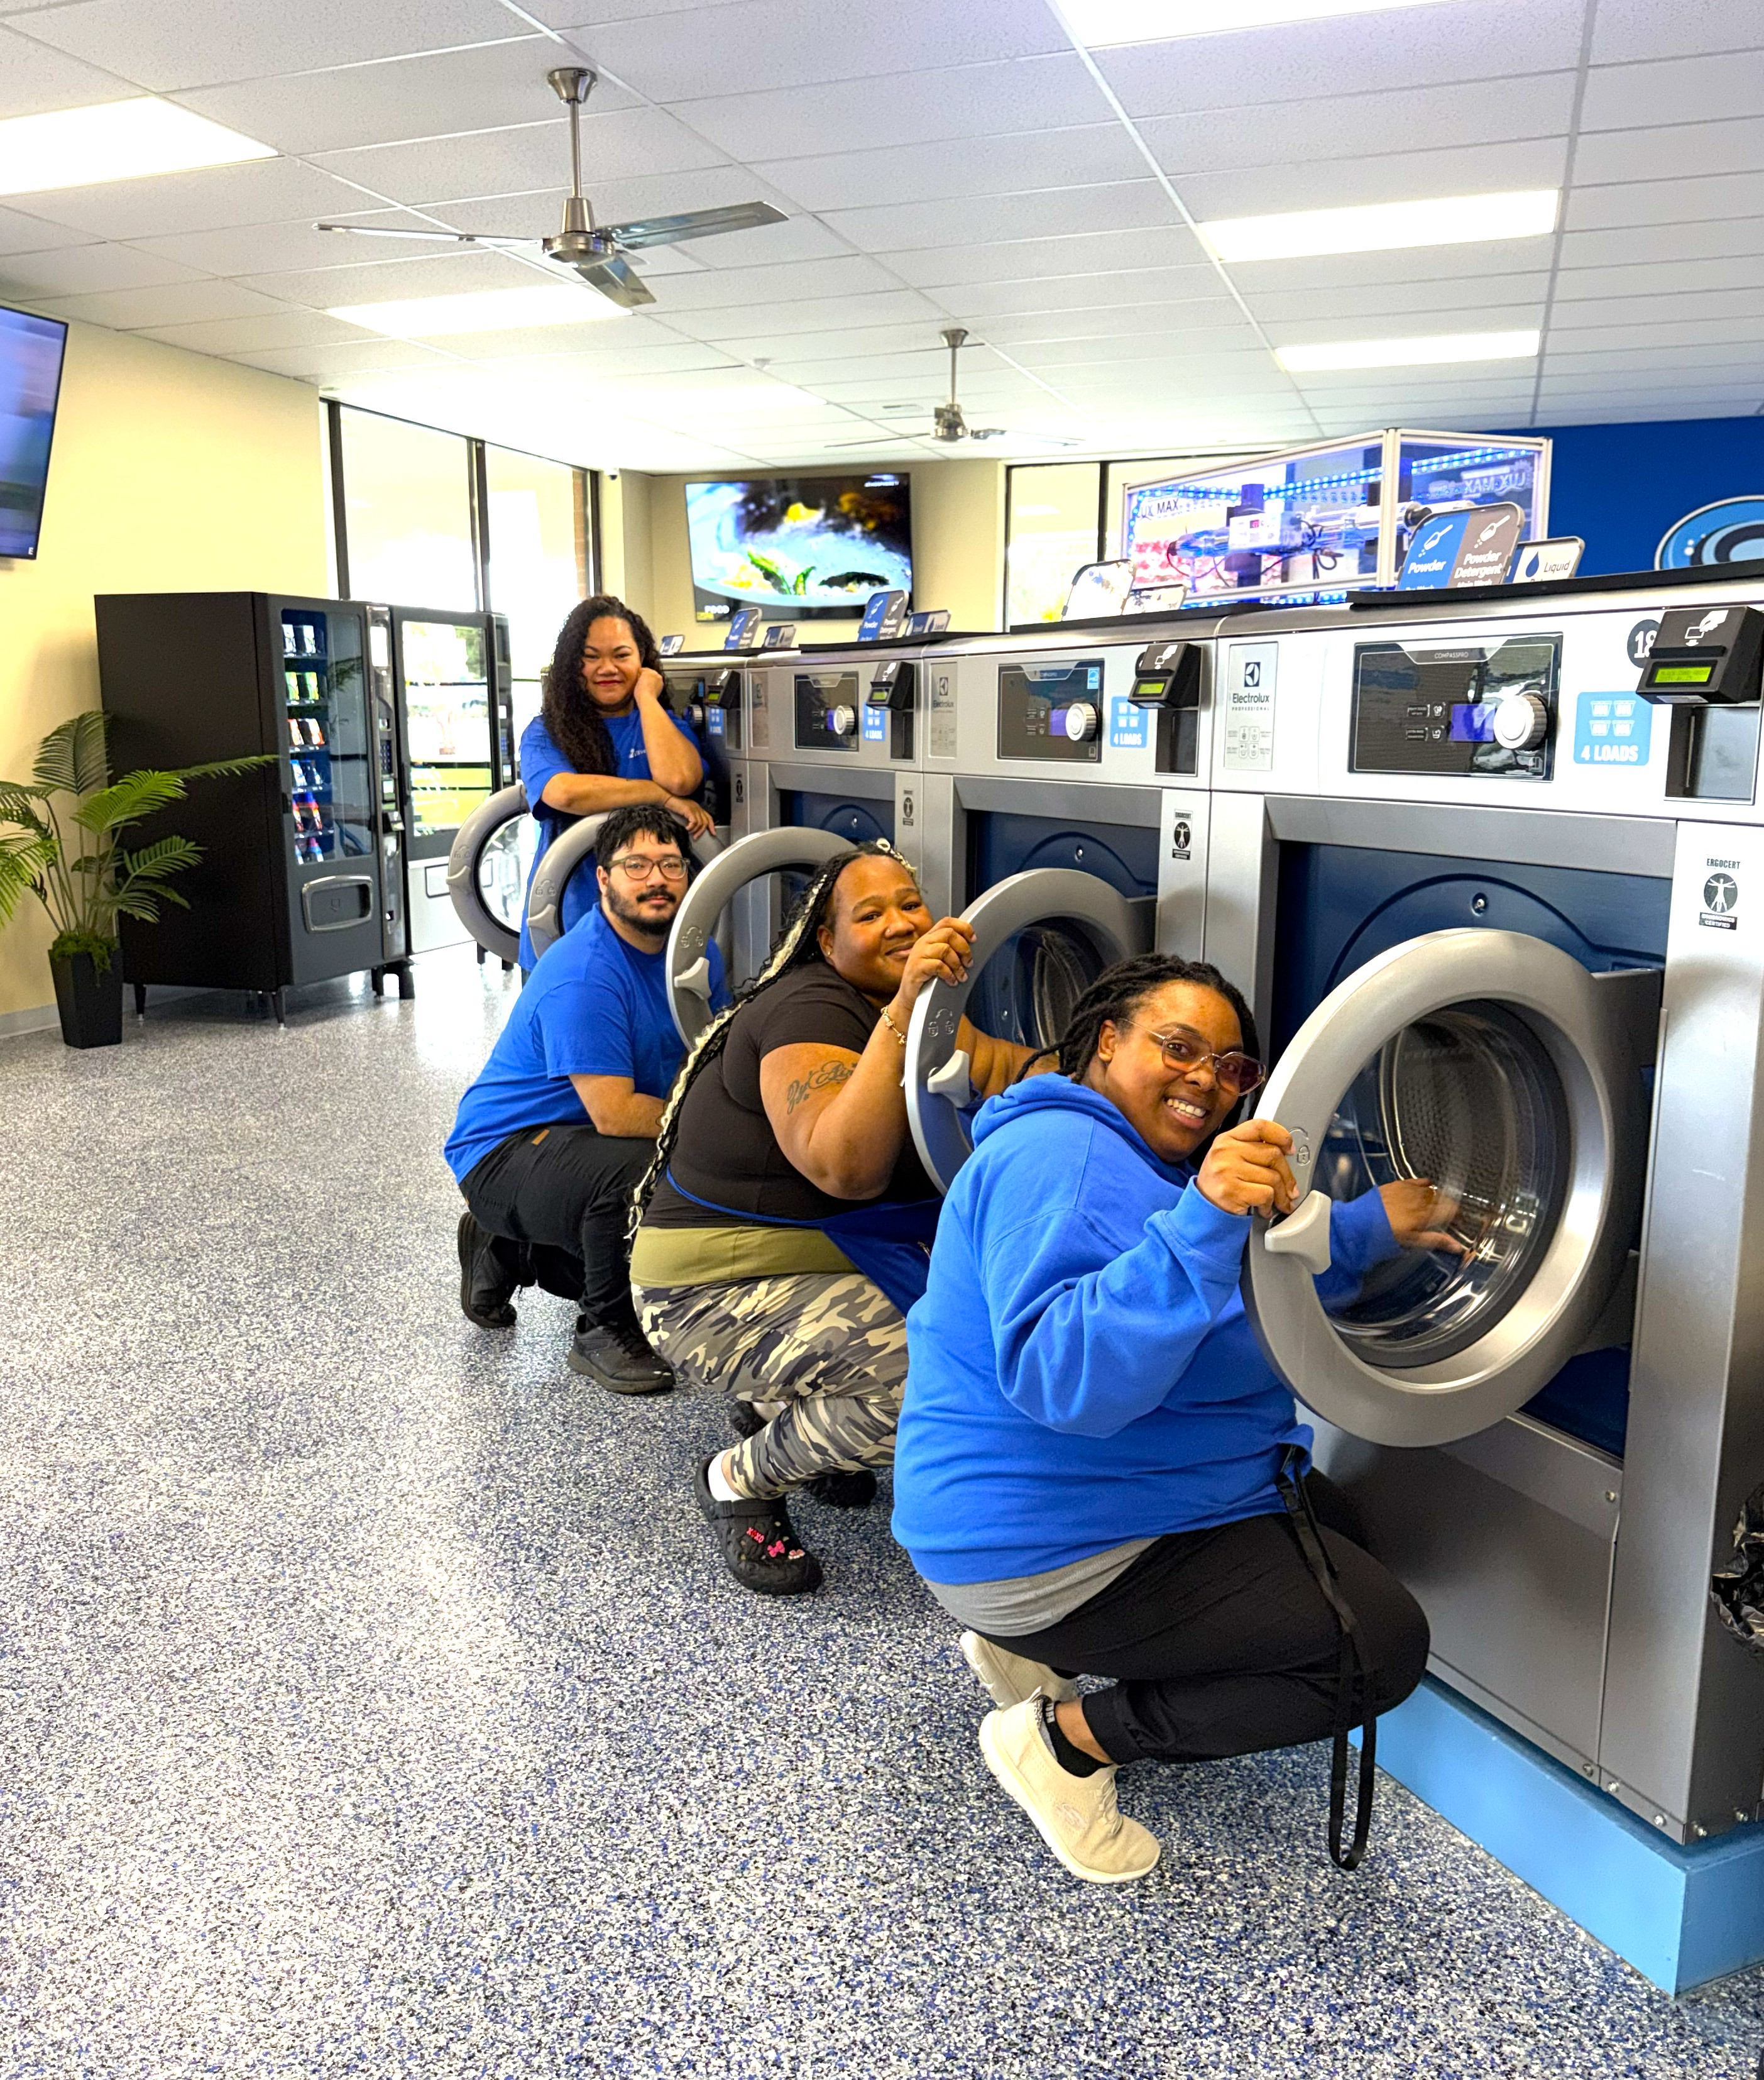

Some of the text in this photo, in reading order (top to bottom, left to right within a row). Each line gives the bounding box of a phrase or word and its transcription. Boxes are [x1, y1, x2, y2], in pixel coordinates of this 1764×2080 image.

[1156, 498, 1178, 514] MAX
[1464, 550, 1502, 564] Powder
[1408, 559, 1447, 574] Powder
[1454, 564, 1503, 579] Detergent
[1543, 560, 1570, 574] Liquid
[704, 605, 730, 614] FOOD
[1232, 693, 1269, 704] Electrolux
[1114, 734, 1142, 746] 4 LOADS
[1580, 744, 1639, 762] 4 LOADS
[1706, 858, 1741, 869] ERGOCERT
